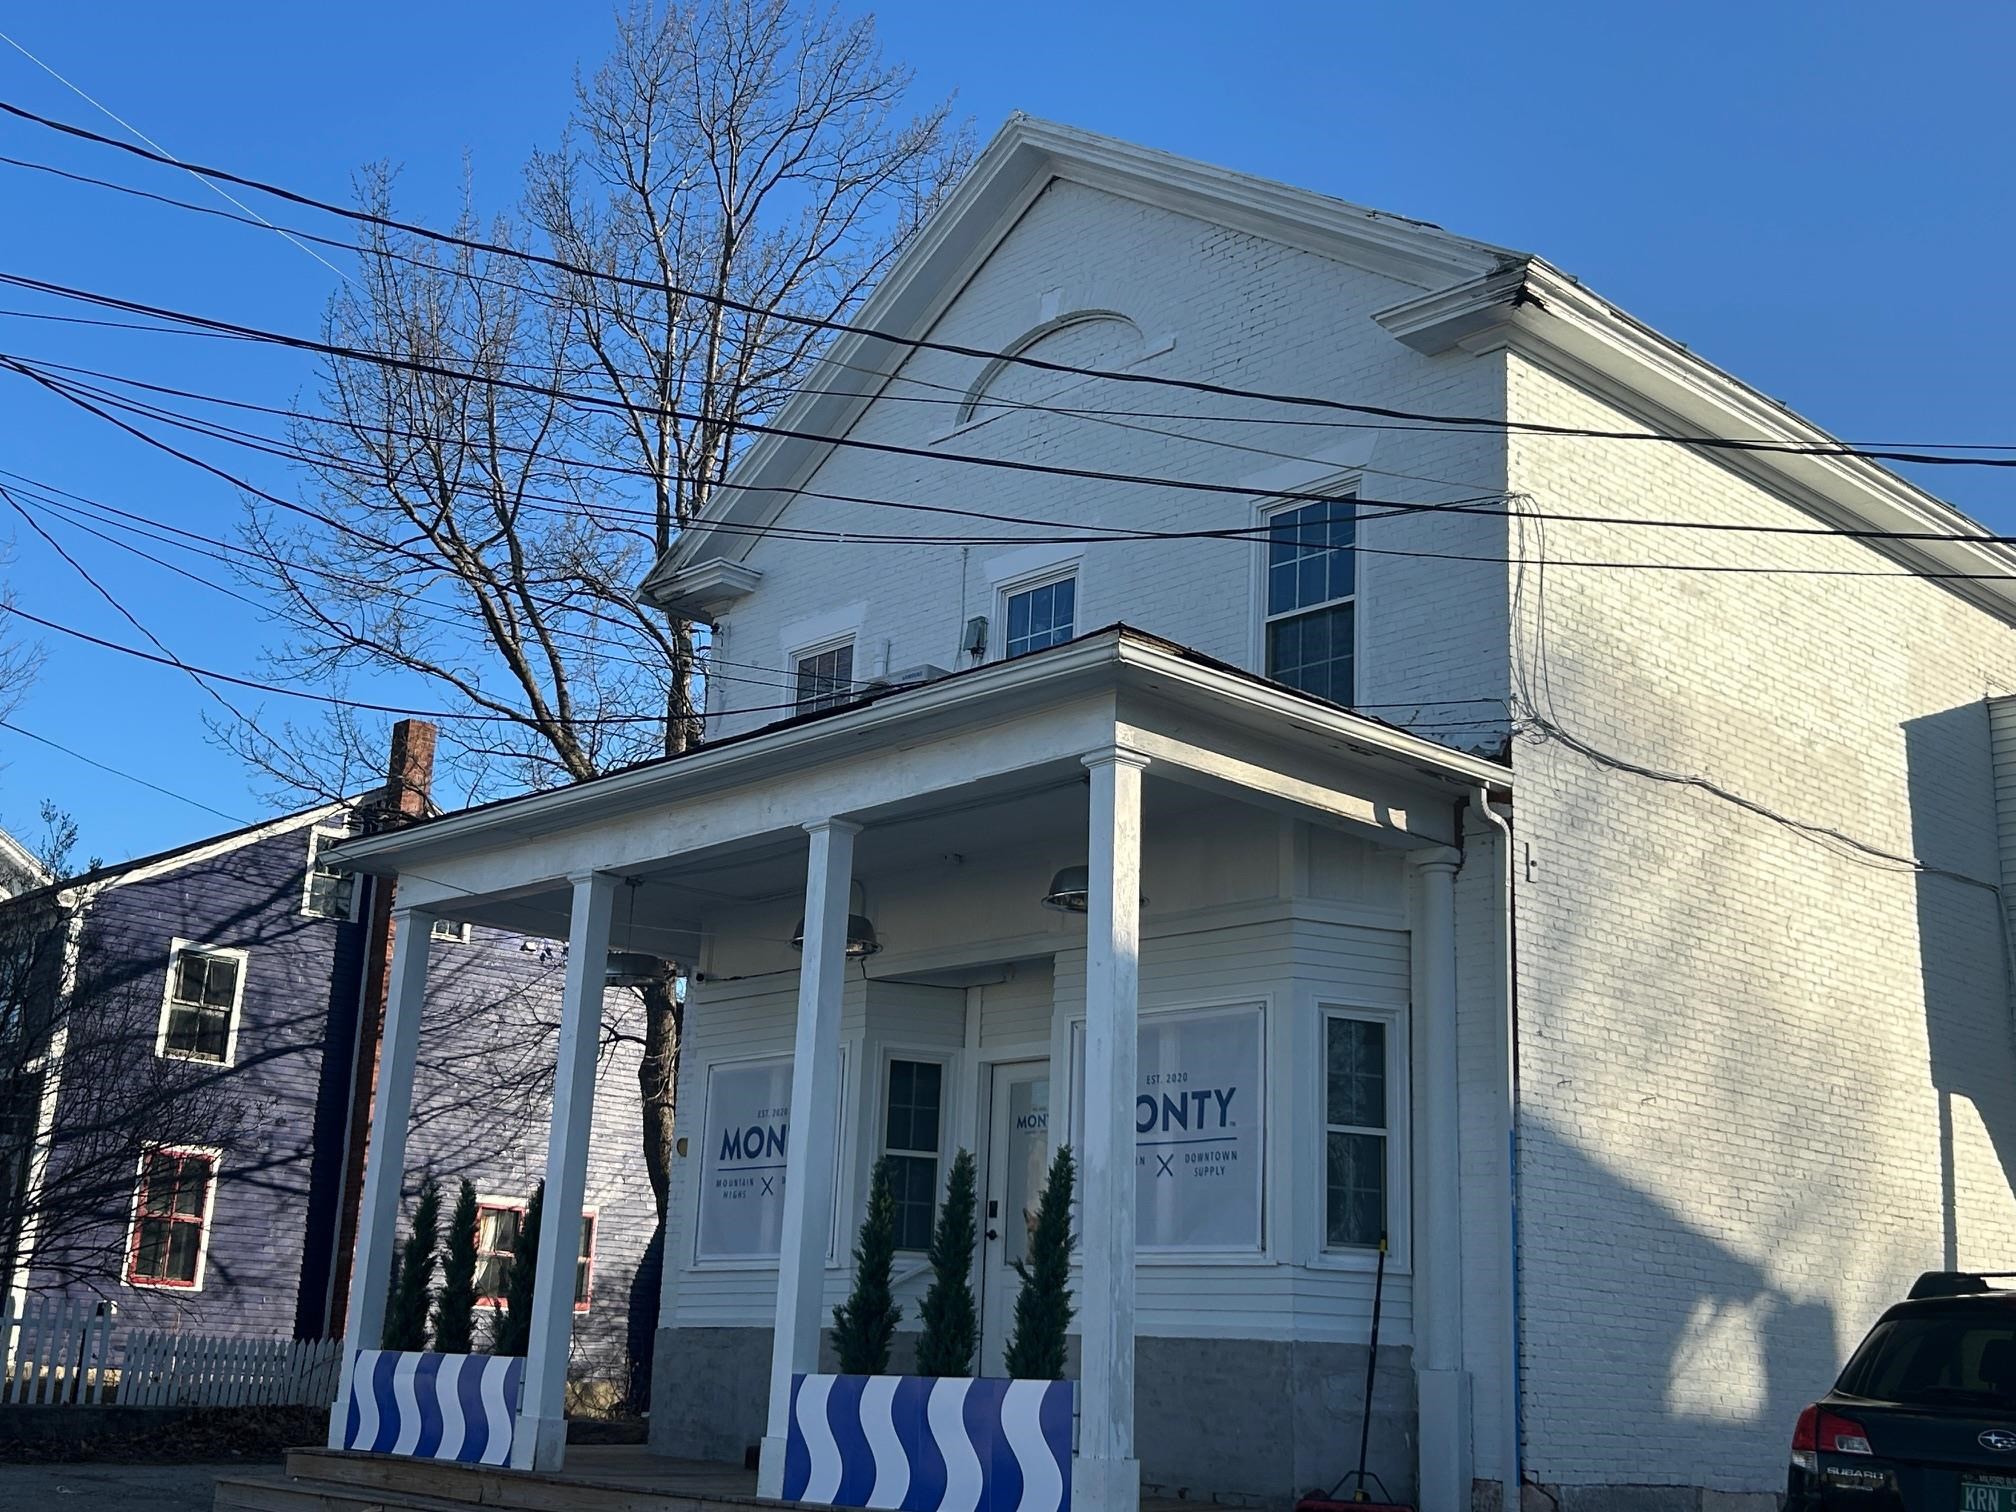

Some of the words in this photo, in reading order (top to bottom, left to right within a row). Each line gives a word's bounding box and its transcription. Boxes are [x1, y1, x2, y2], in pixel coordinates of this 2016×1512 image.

[1166, 1072, 1188, 1083] 2020
[1136, 1087, 1236, 1133] ONTY
[1017, 1113, 1049, 1129] MON
[719, 1124, 790, 1161] MON
[1185, 1151, 1238, 1164] DOWNTOWN
[1194, 1166, 1226, 1177] SUPPLY
[716, 1177, 754, 1188] MOUNTAIN
[1827, 1466, 1884, 1480] SUBARU
[1965, 1487, 2000, 1512] KRN
